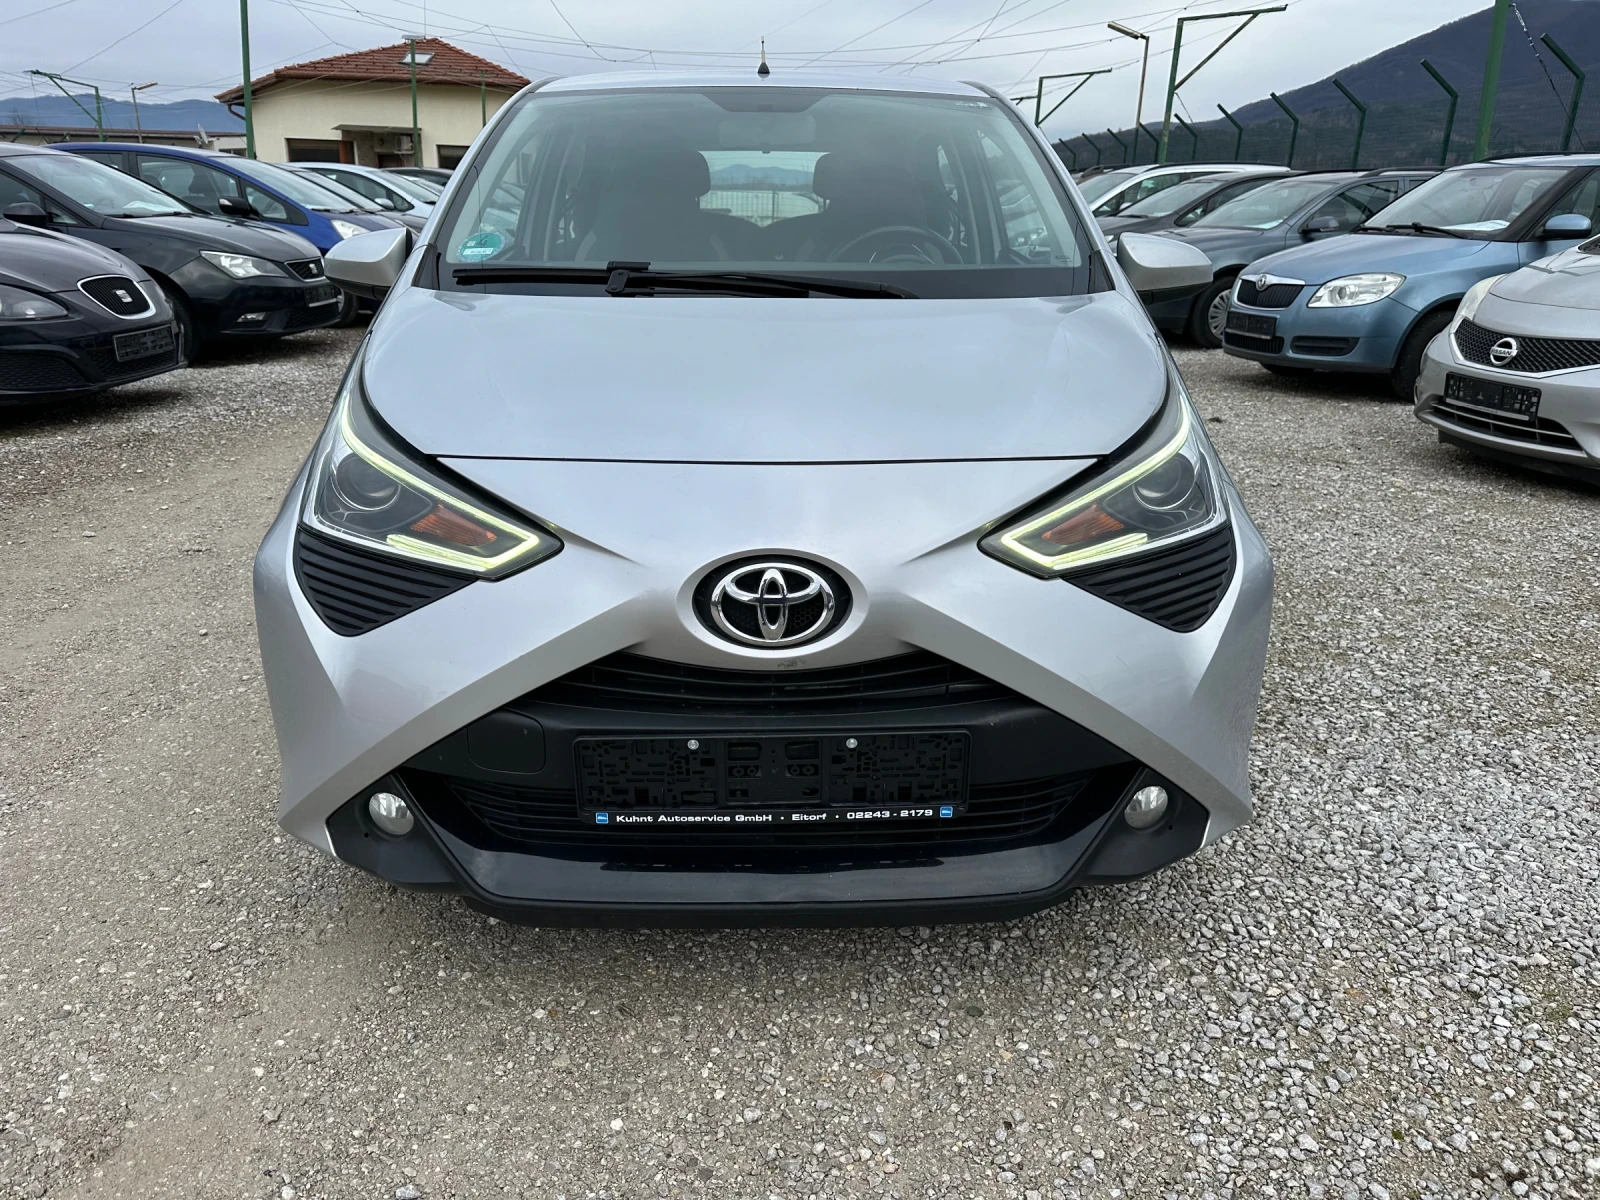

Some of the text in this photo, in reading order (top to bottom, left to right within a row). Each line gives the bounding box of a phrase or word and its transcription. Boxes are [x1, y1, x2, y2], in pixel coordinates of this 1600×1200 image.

[658, 814, 731, 822] Autoservice
[735, 814, 773, 822] GmbH
[791, 813, 827, 821] Eitorf
